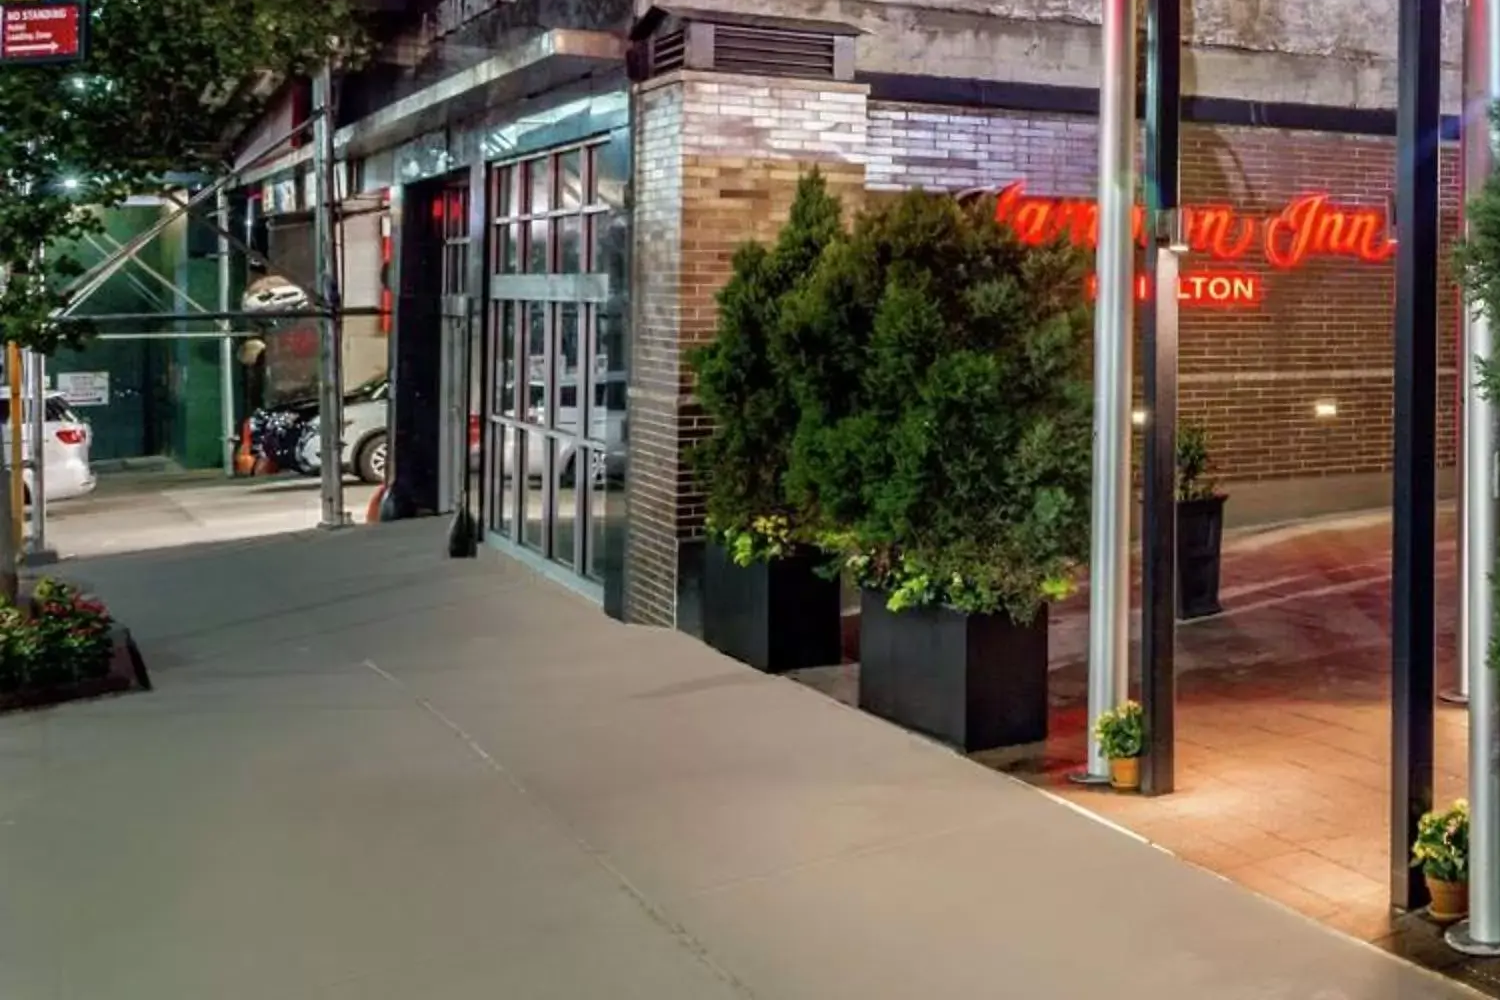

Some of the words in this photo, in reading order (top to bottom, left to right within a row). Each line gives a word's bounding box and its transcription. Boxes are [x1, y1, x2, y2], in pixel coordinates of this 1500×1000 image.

[7, 11, 20, 21] NO
[1265, 192, 1398, 268] Inn
[1138, 275, 1254, 300] LTON
